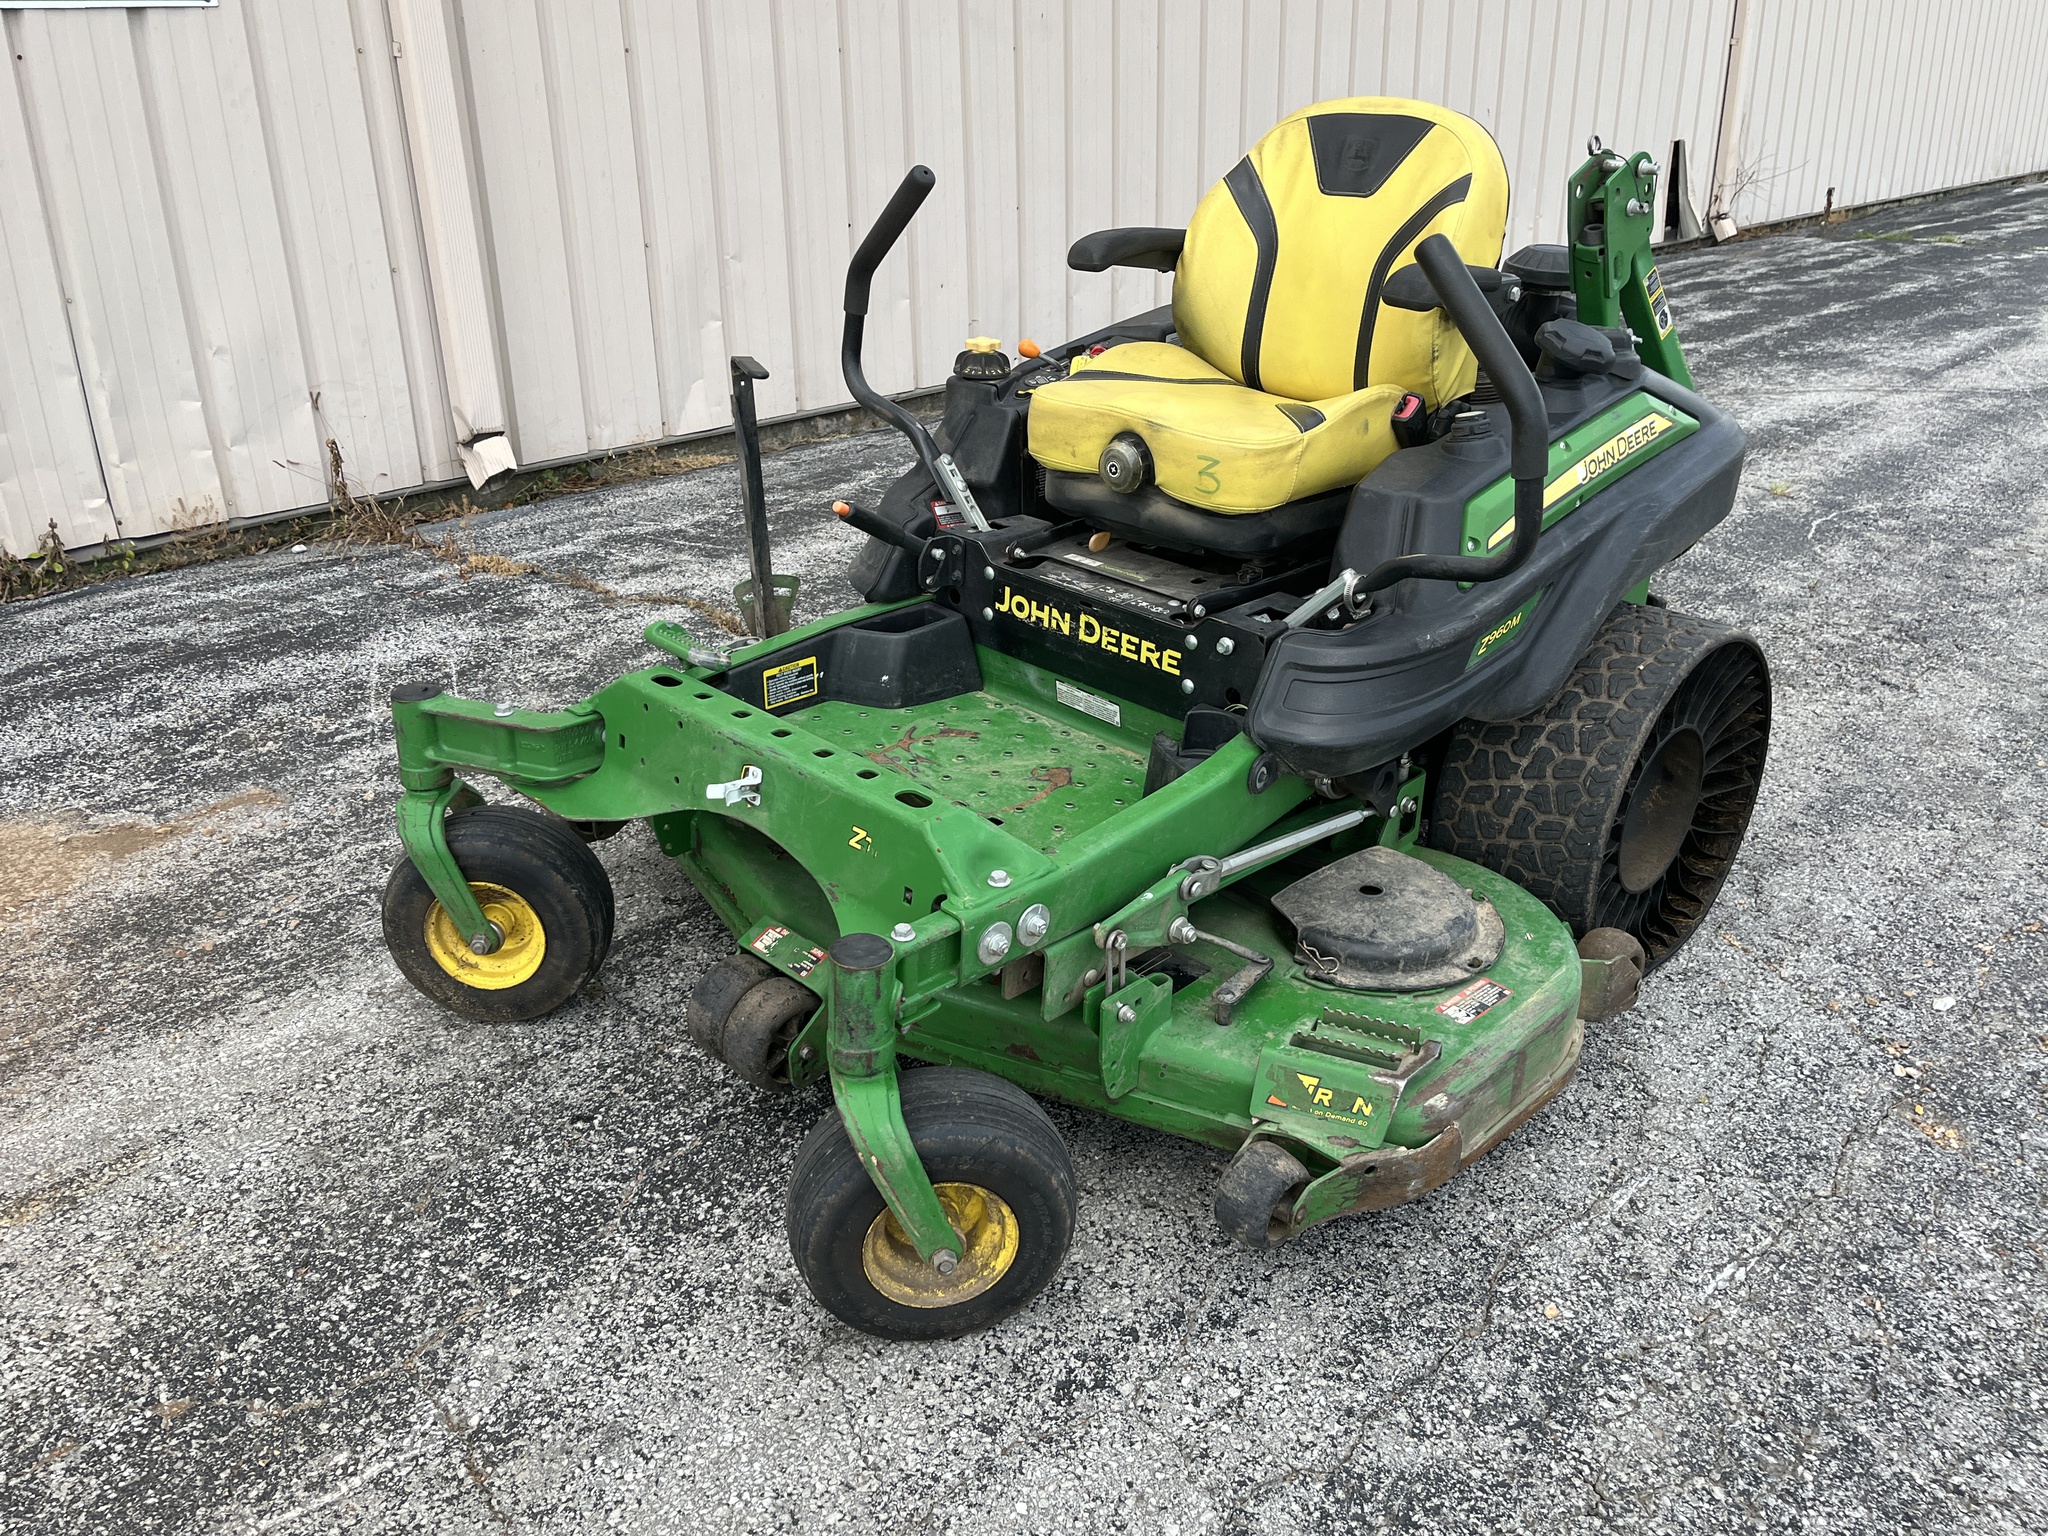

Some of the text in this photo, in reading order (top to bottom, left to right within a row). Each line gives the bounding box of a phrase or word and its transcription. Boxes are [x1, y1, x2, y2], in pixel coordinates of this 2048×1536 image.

[1581, 420, 1659, 484] JOHN DEERE
[1194, 455, 1222, 495] 3
[994, 585, 1071, 636] JOHN
[1078, 612, 1183, 677] DEERE
[1478, 611, 1523, 656] Z960M
[1325, 1111, 1356, 1124] Demand
[1357, 1119, 1368, 1127] 60
